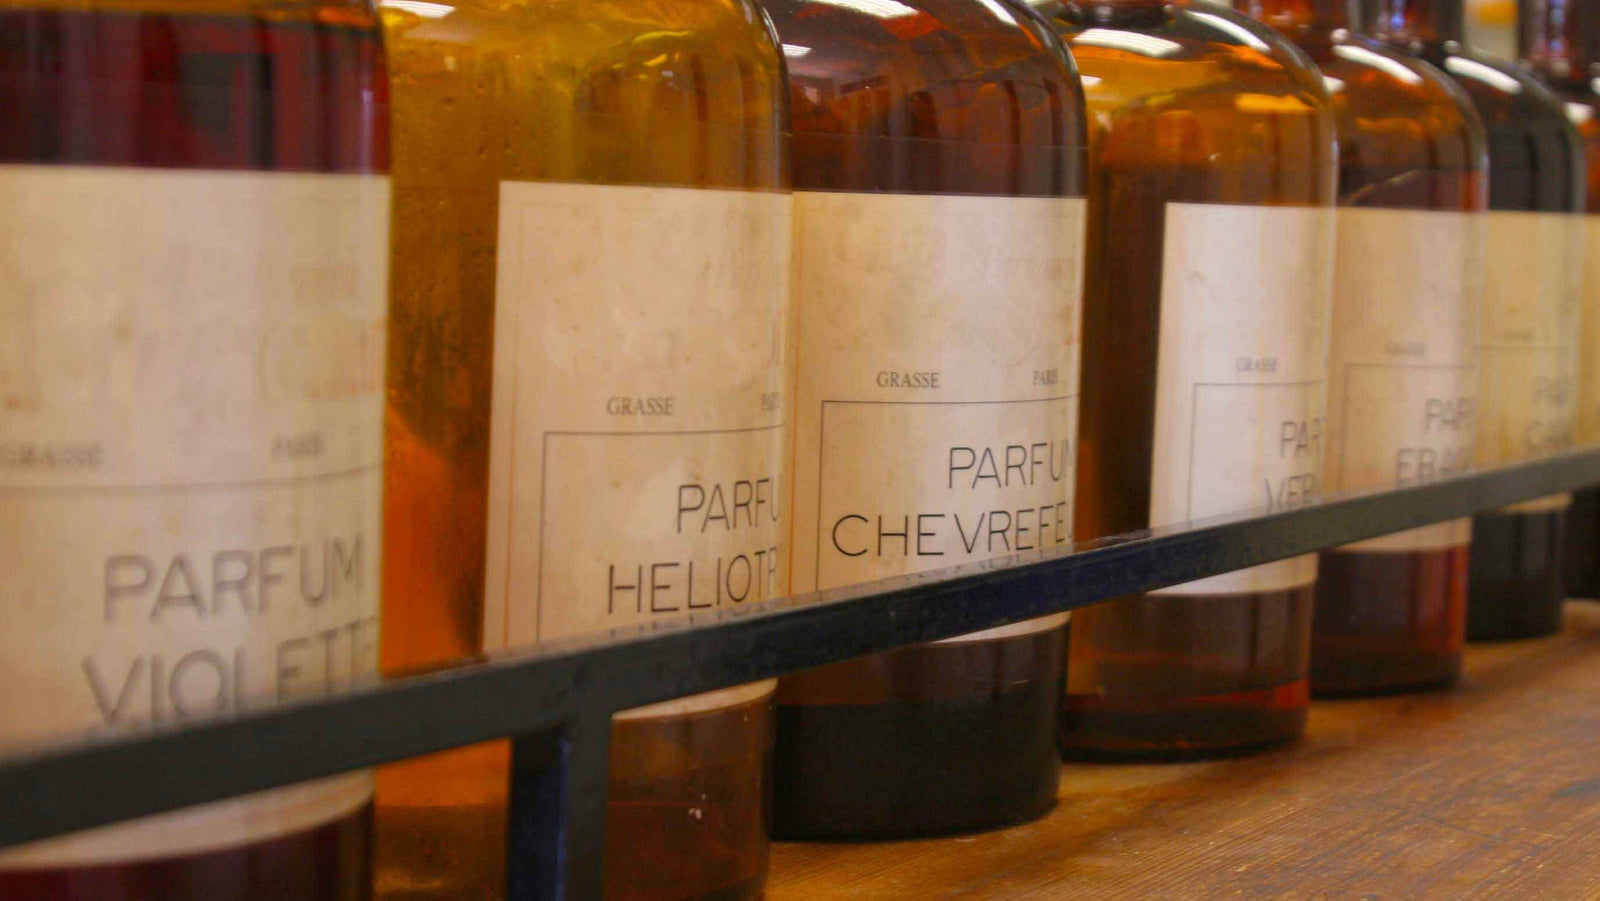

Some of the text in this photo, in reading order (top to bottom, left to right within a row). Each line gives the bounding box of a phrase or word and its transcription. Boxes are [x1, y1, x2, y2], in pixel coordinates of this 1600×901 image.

[876, 372, 940, 388] GRASSE
[606, 396, 675, 416] GRASSE
[102, 534, 364, 622] PARFUM
